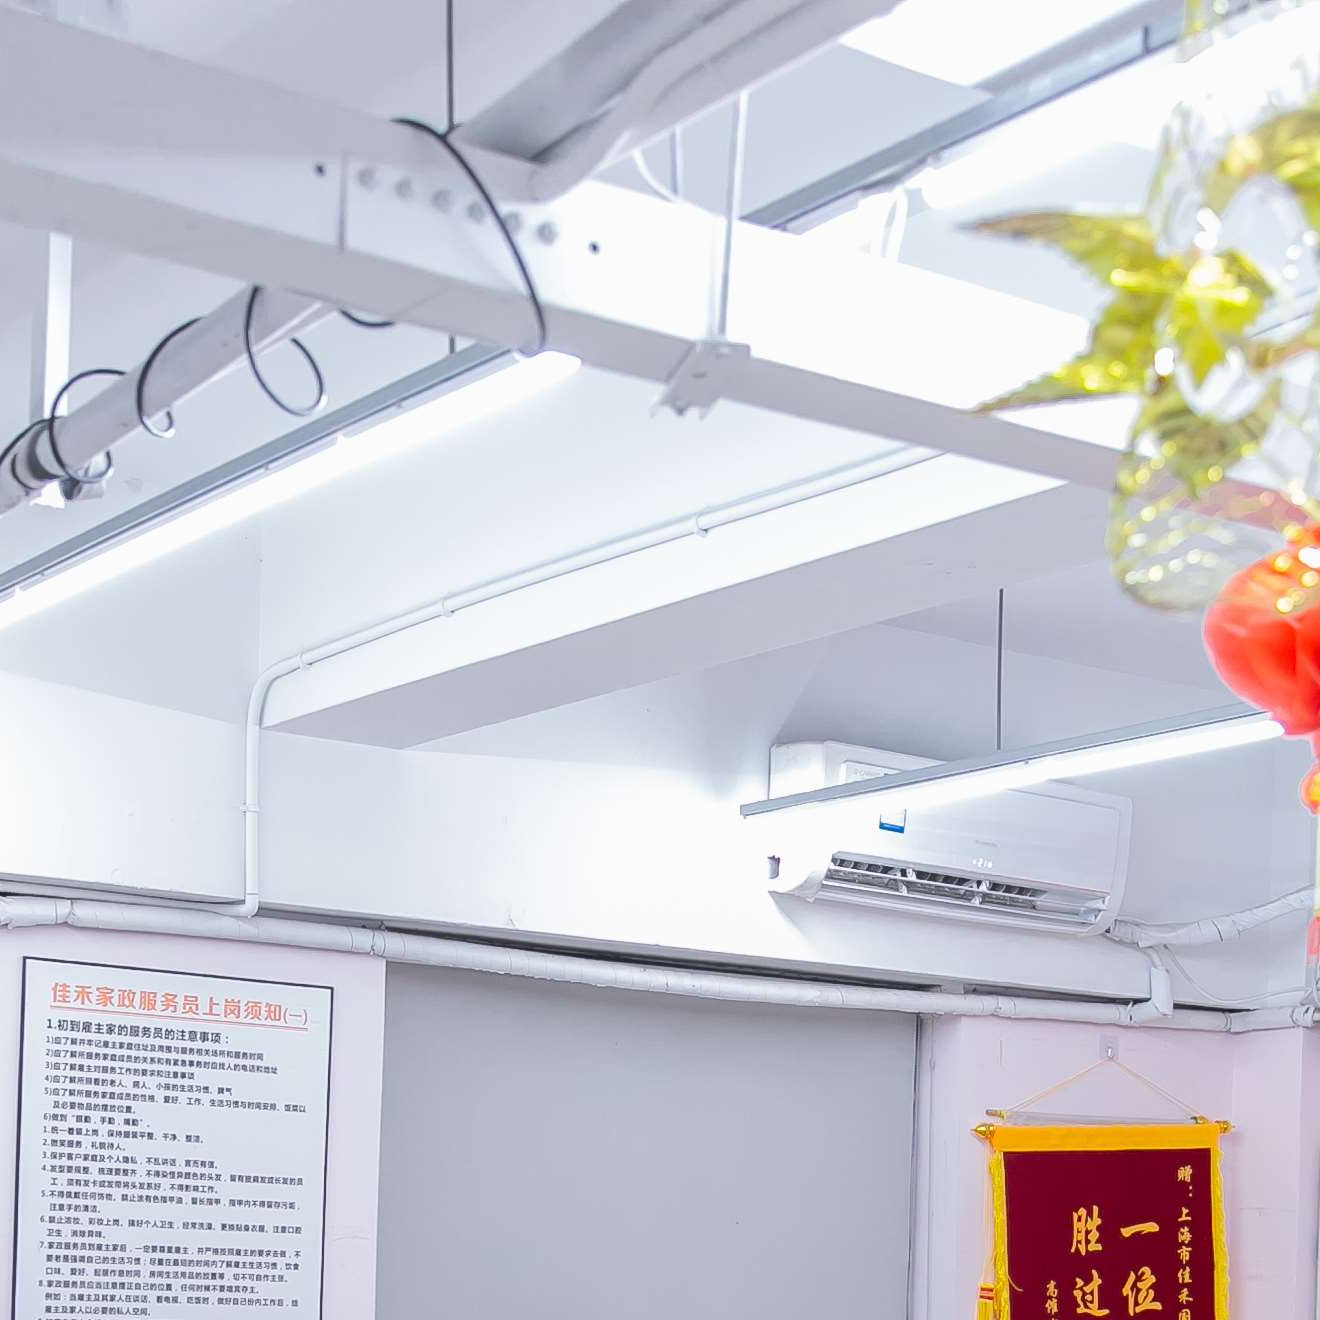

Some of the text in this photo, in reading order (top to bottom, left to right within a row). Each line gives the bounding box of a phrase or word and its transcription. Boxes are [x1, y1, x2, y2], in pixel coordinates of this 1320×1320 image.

[51, 982, 308, 1025] 佳禾家政服务员上岗须知(一)
